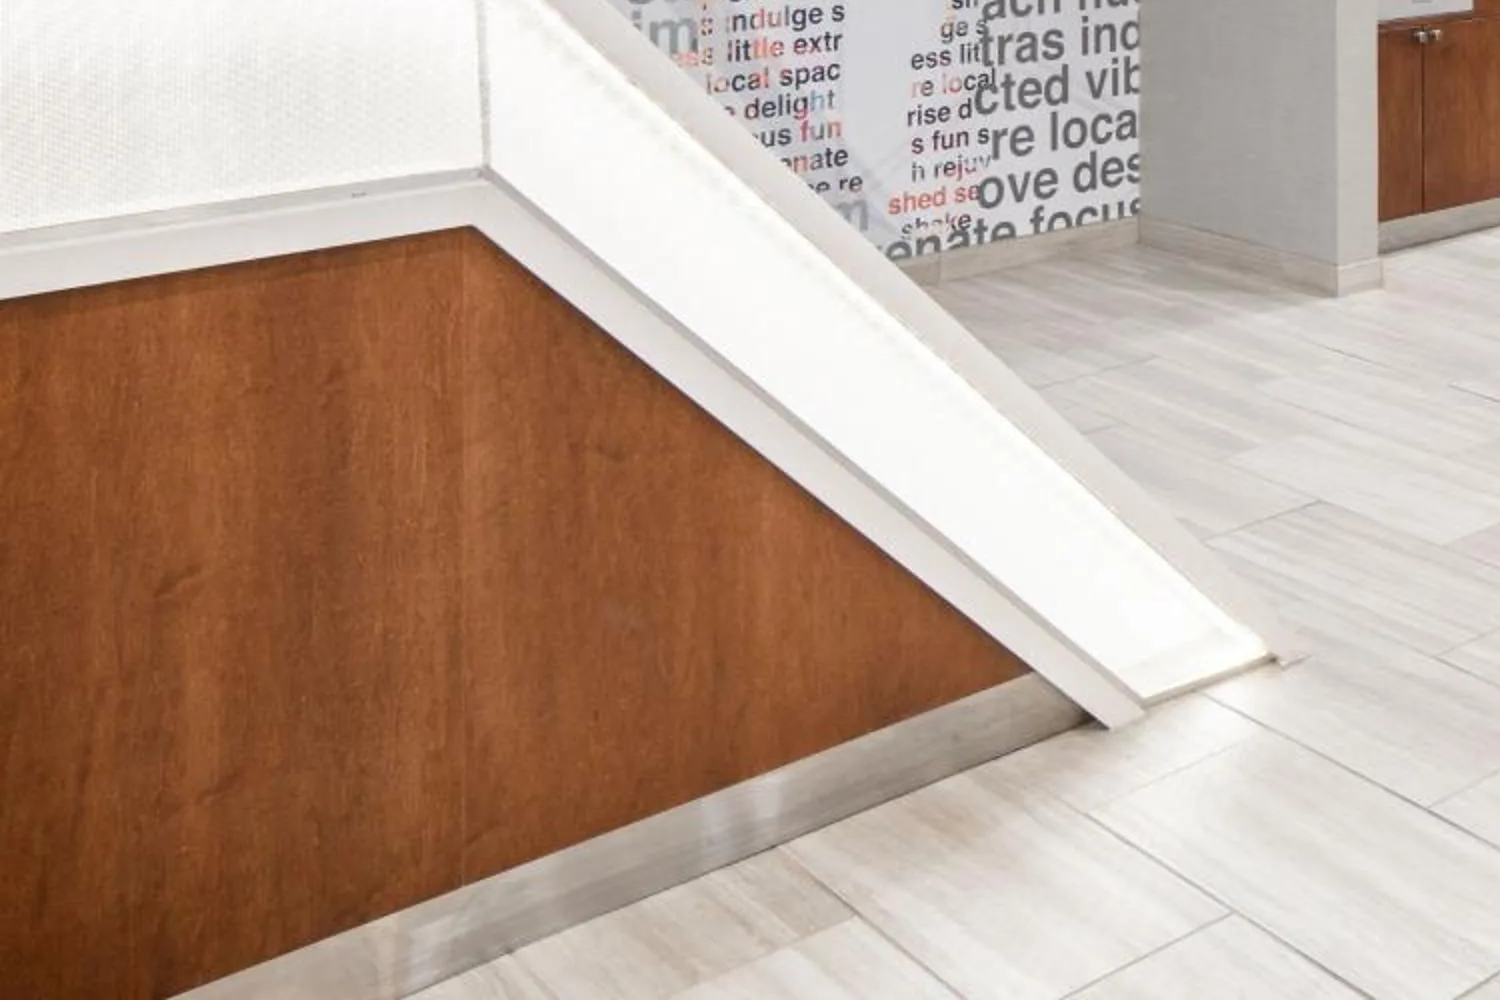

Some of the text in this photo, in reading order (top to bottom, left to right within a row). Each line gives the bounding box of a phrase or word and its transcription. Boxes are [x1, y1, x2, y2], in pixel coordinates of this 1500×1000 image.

[831, 4, 845, 22] s
[728, 36, 784, 62] little
[793, 32, 842, 54] extr
[911, 49, 952, 70] ess
[981, 26, 1064, 68] tras
[707, 63, 841, 95] local spac
[942, 67, 996, 94] local
[975, 64, 1069, 115] cted
[744, 90, 836, 120] delight
[907, 97, 972, 126] rise d
[800, 120, 842, 142] fun
[911, 127, 989, 155] s fun s
[993, 109, 1137, 160] re loca
[888, 186, 946, 215] shed
[977, 166, 1059, 208] ove
